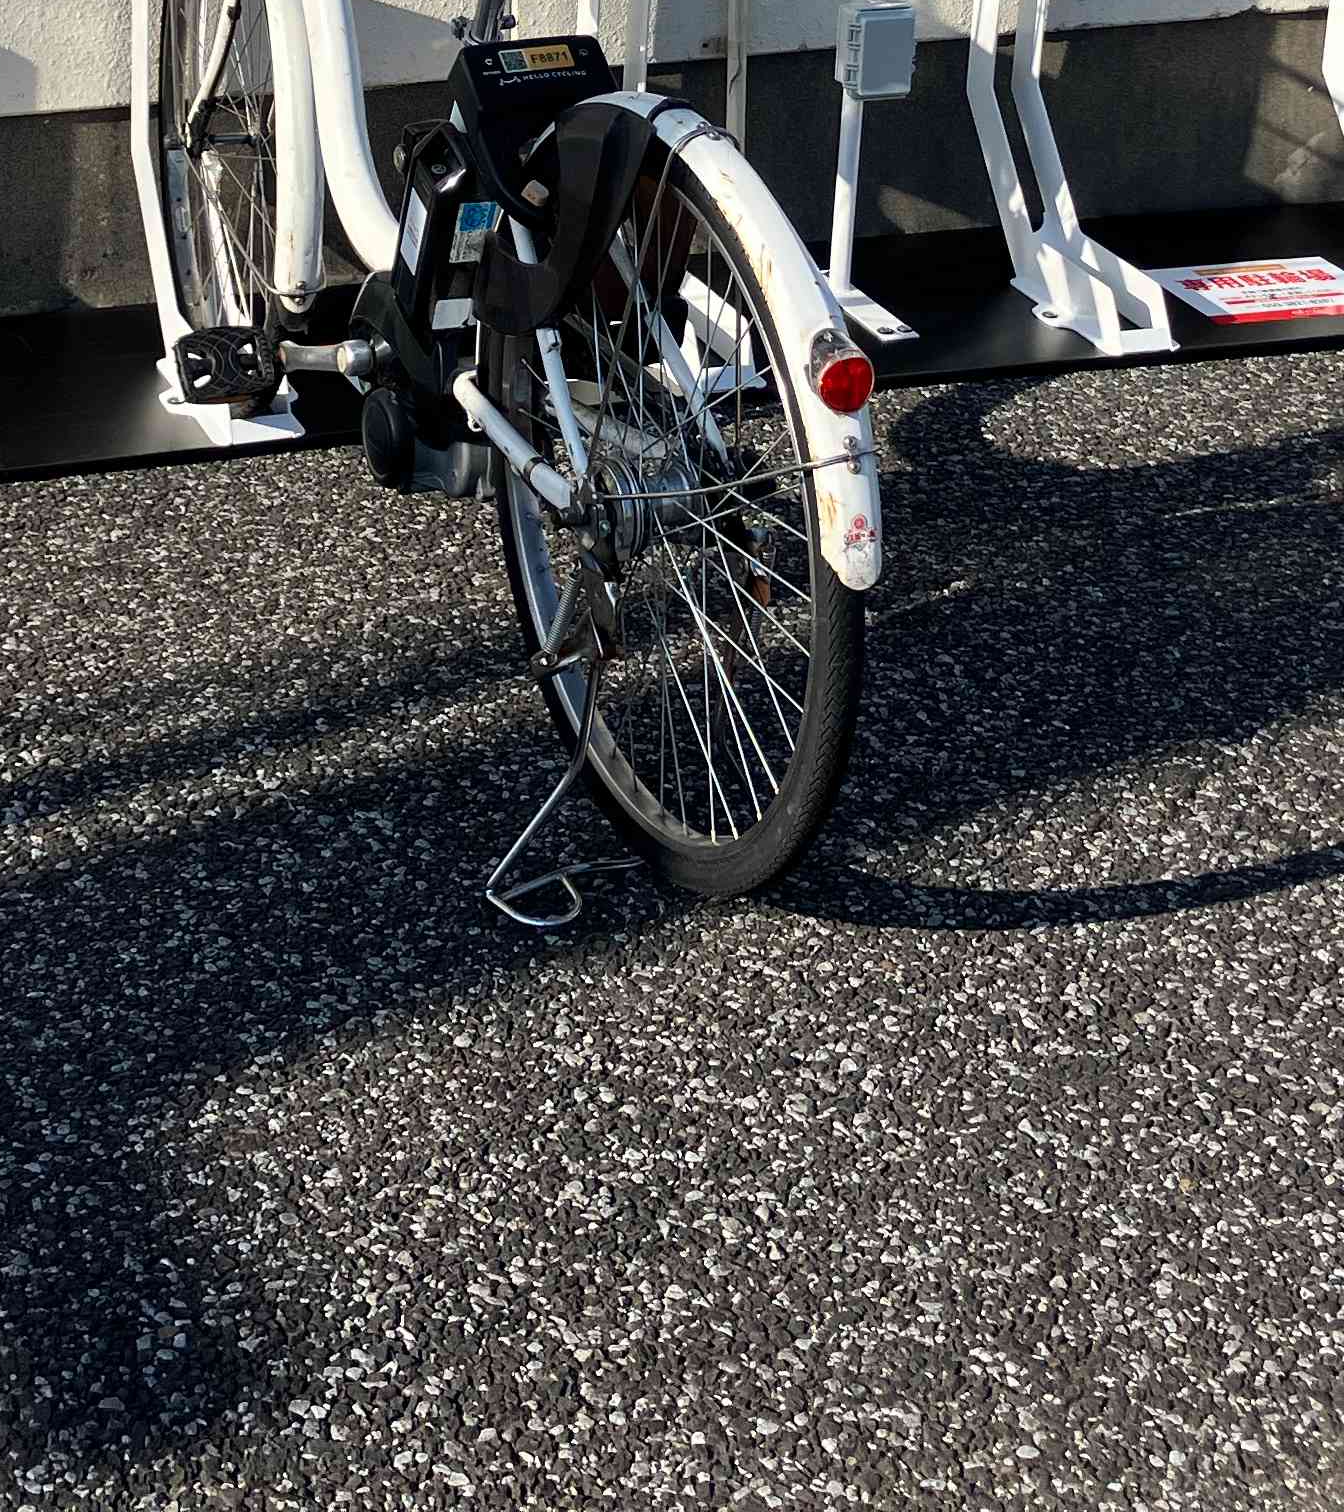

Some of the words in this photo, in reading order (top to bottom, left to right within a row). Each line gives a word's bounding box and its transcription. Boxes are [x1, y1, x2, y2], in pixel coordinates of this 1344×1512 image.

[530, 51, 569, 64] F8871
[522, 72, 550, 81] HELLO
[551, 70, 587, 78] CYCLING
[1176, 269, 1337, 291] 専用駐輪場
